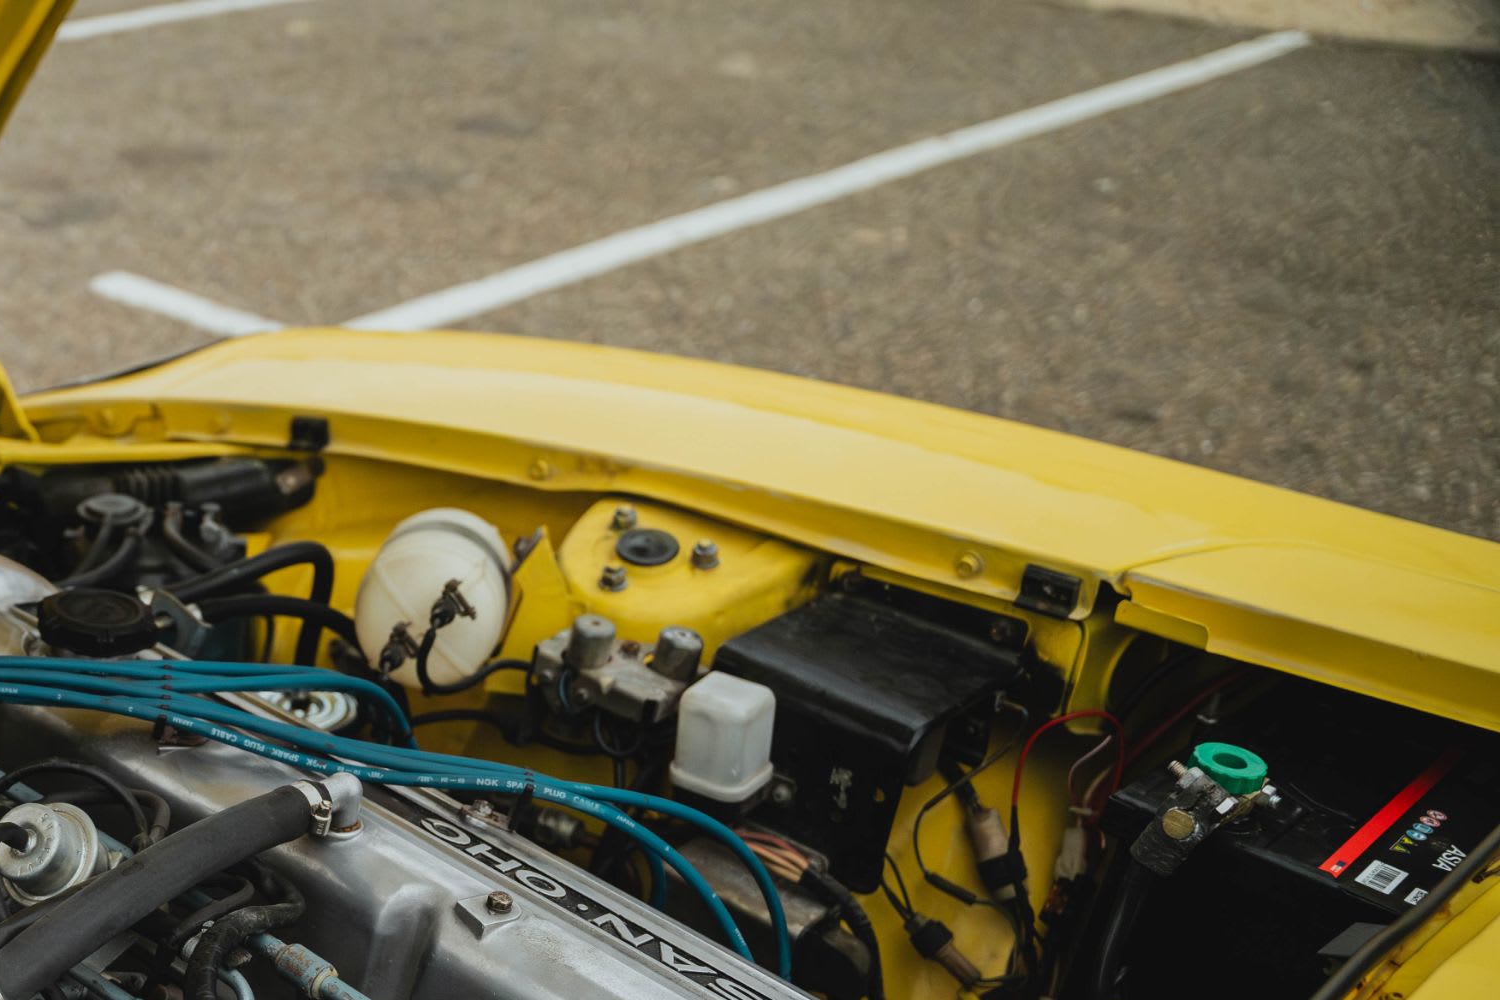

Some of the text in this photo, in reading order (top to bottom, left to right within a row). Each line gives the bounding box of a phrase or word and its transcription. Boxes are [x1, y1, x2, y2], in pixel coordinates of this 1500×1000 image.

[210, 727, 238, 743] CABLE
[243, 738, 266, 752] PLUG
[270, 747, 300, 763] SPARK
[475, 777, 500, 788] NGK
[542, 786, 568, 800] PLUG
